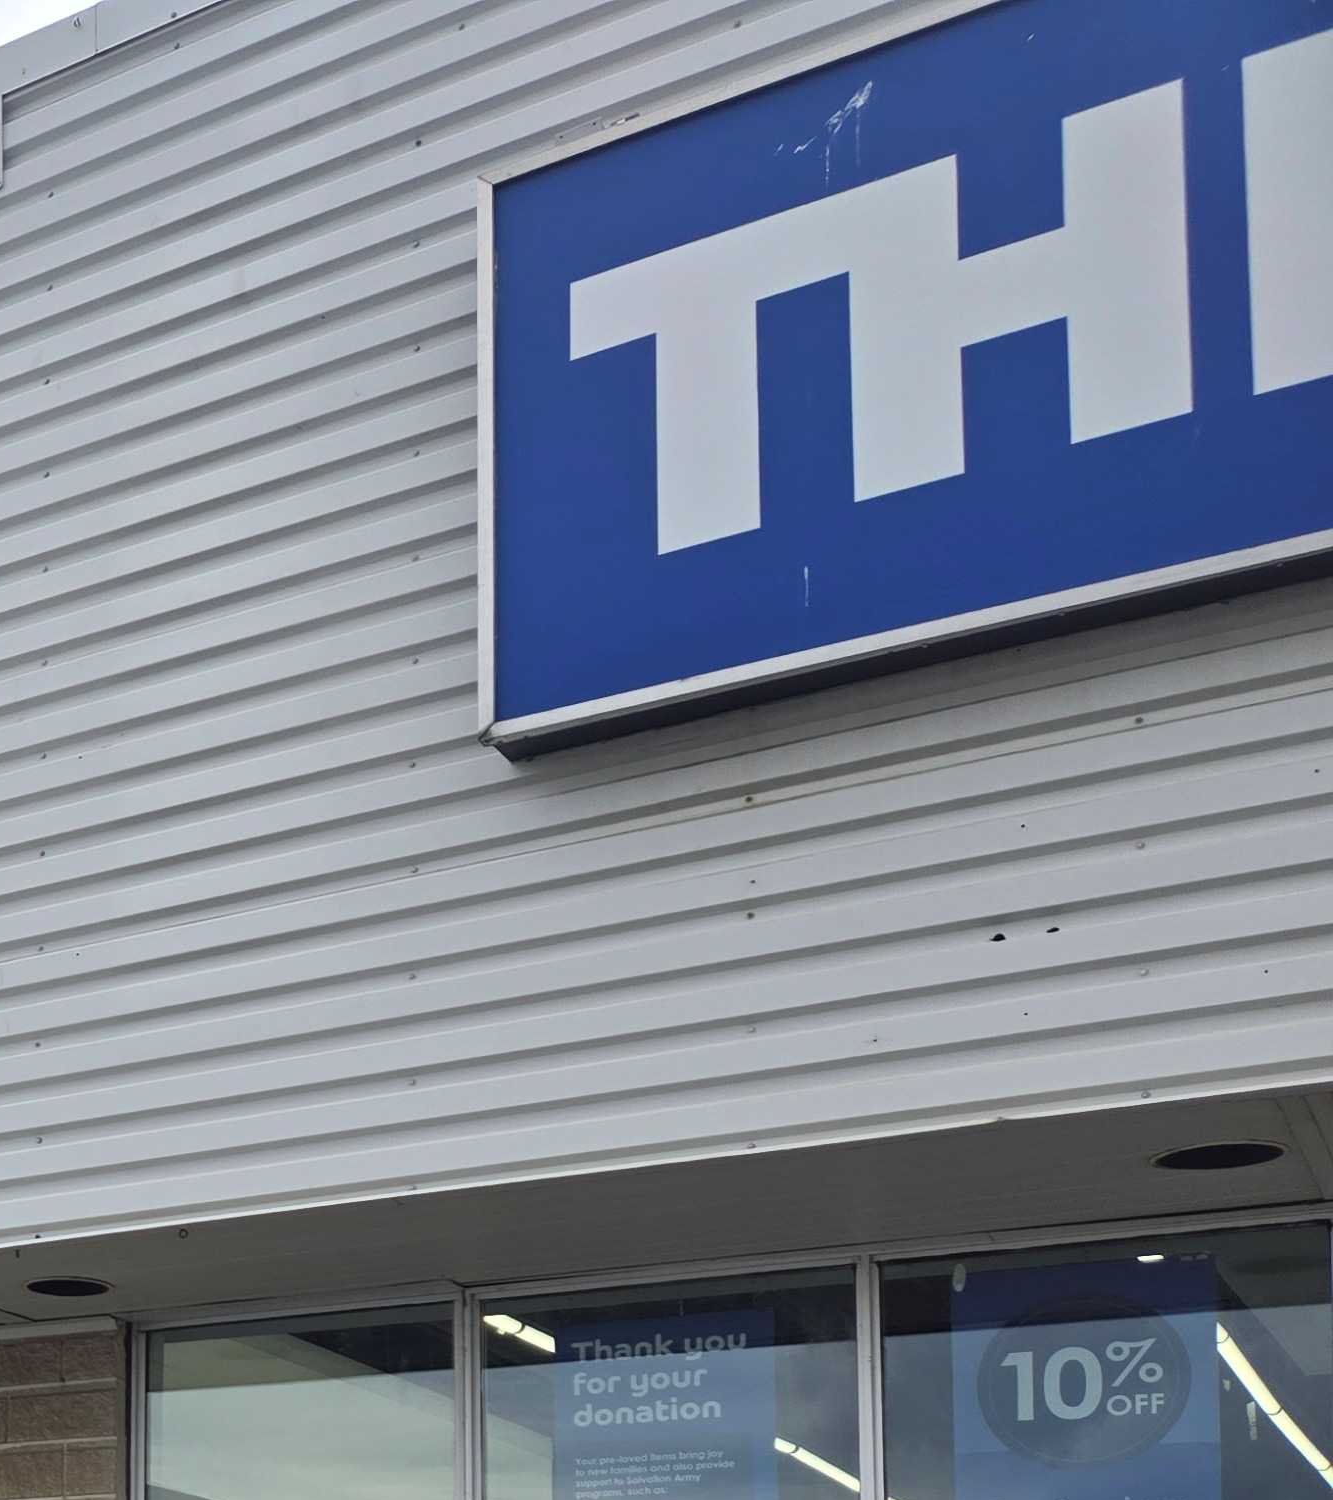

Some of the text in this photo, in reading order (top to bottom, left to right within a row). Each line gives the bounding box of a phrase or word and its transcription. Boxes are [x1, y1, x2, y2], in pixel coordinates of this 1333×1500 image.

[571, 1332, 747, 1362] Thank you
[573, 1368, 708, 1397] for your
[573, 1397, 722, 1427] donation
[1106, 1392, 1165, 1417] OFF
[599, 1454, 648, 1466] pre-loved
[674, 1473, 701, 1483] Army
